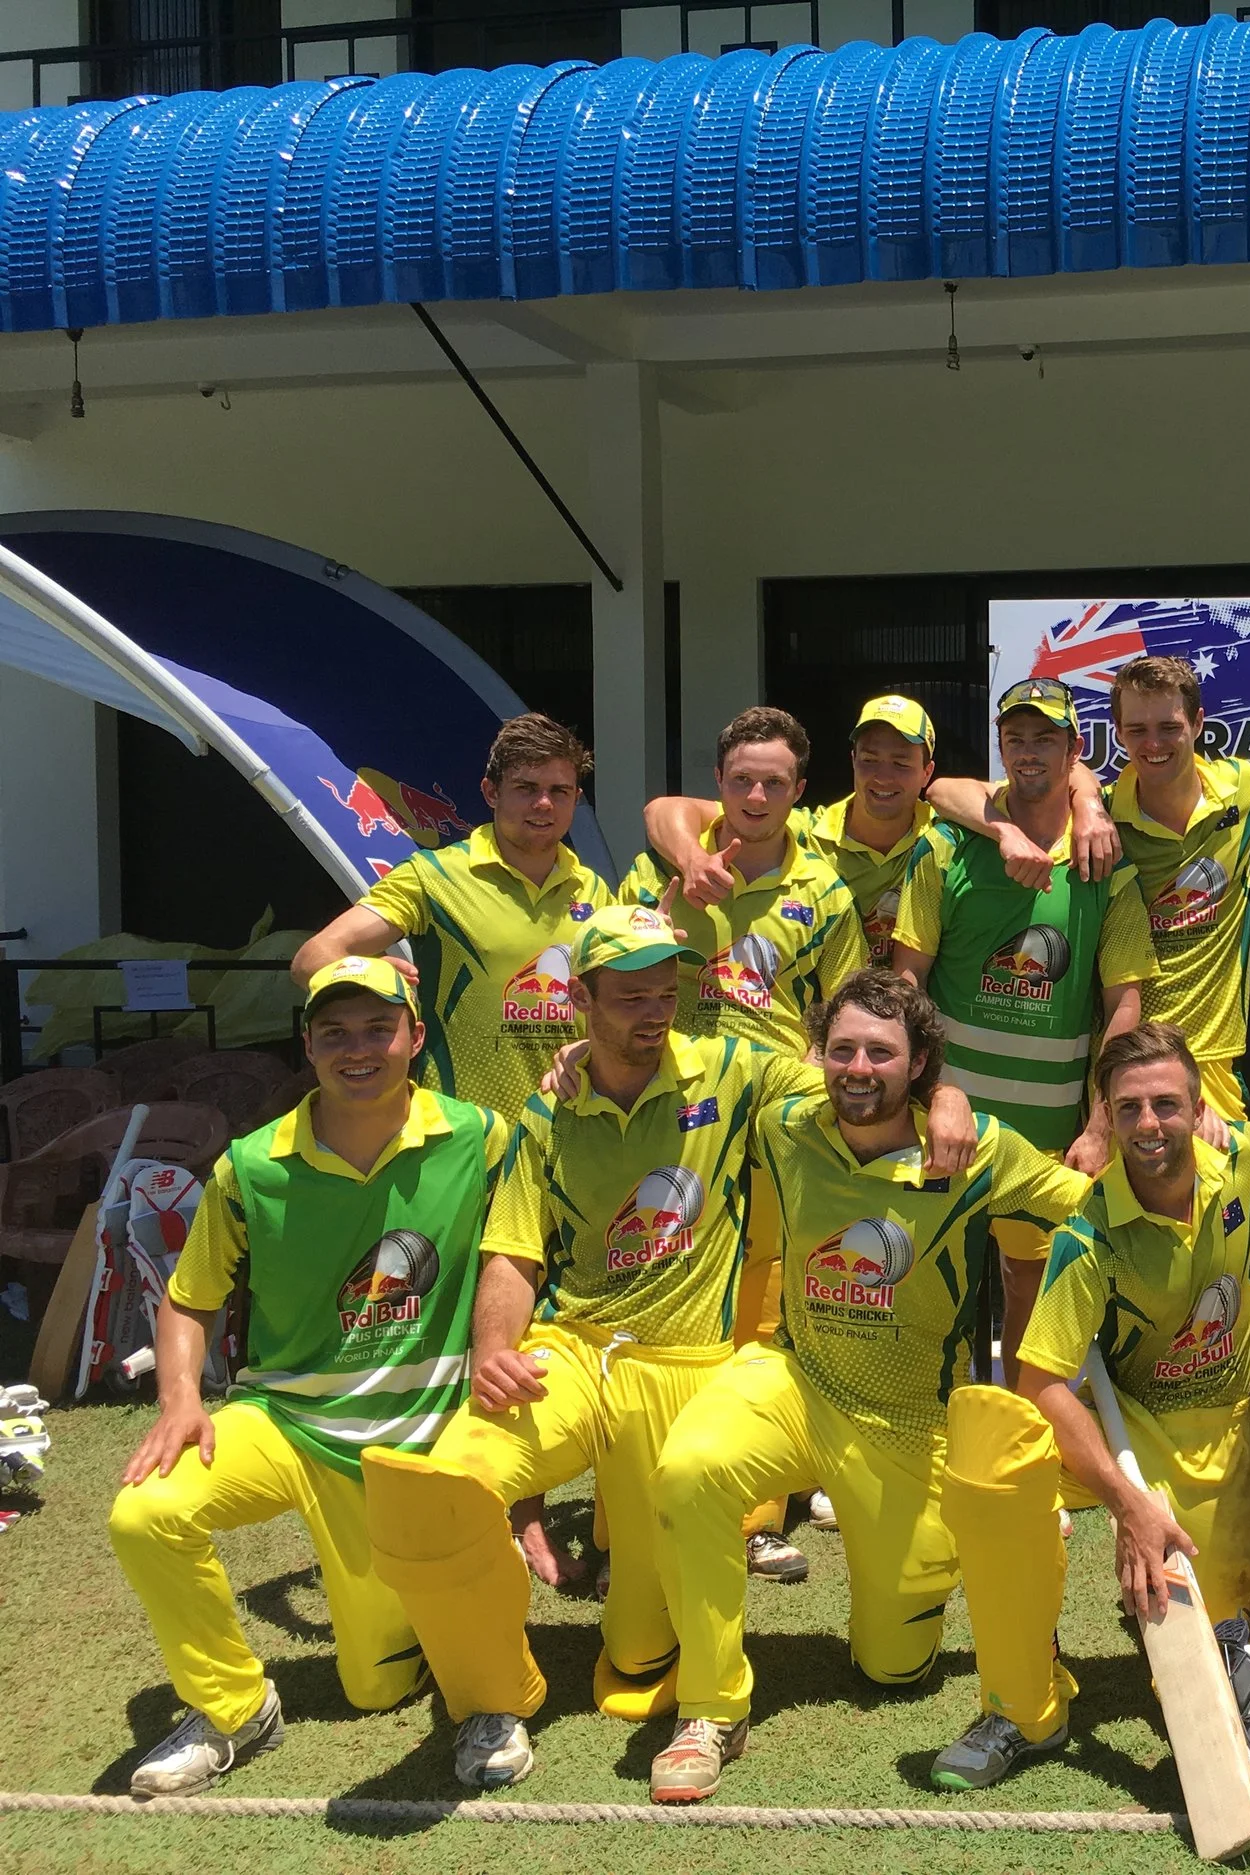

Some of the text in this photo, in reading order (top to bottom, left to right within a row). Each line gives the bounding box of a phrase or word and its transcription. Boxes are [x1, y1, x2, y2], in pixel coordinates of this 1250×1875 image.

[1150, 904, 1218, 930] Red Bull
[701, 982, 772, 1008] Red Bull
[981, 974, 1053, 1001] Red Bull
[503, 1000, 543, 1021] Red
[698, 1002, 737, 1012] CAMPUS
[975, 994, 1052, 1012] CAMPUS CRICKET
[983, 1012, 1009, 1023] WORLD
[501, 1024, 541, 1033] CAMPUS
[607, 1227, 693, 1271] Red Bull
[806, 1275, 894, 1308] Red Bull
[339, 1296, 420, 1333] Rd Bull
[805, 1301, 895, 1321] CAMPUS CRICKET
[374, 1323, 422, 1338] CRICKET
[814, 1324, 877, 1340] WORLD FINALS
[334, 1350, 369, 1363] WORLD
[1155, 1353, 1197, 1378] Red
[1150, 1378, 1190, 1390] CAMP
